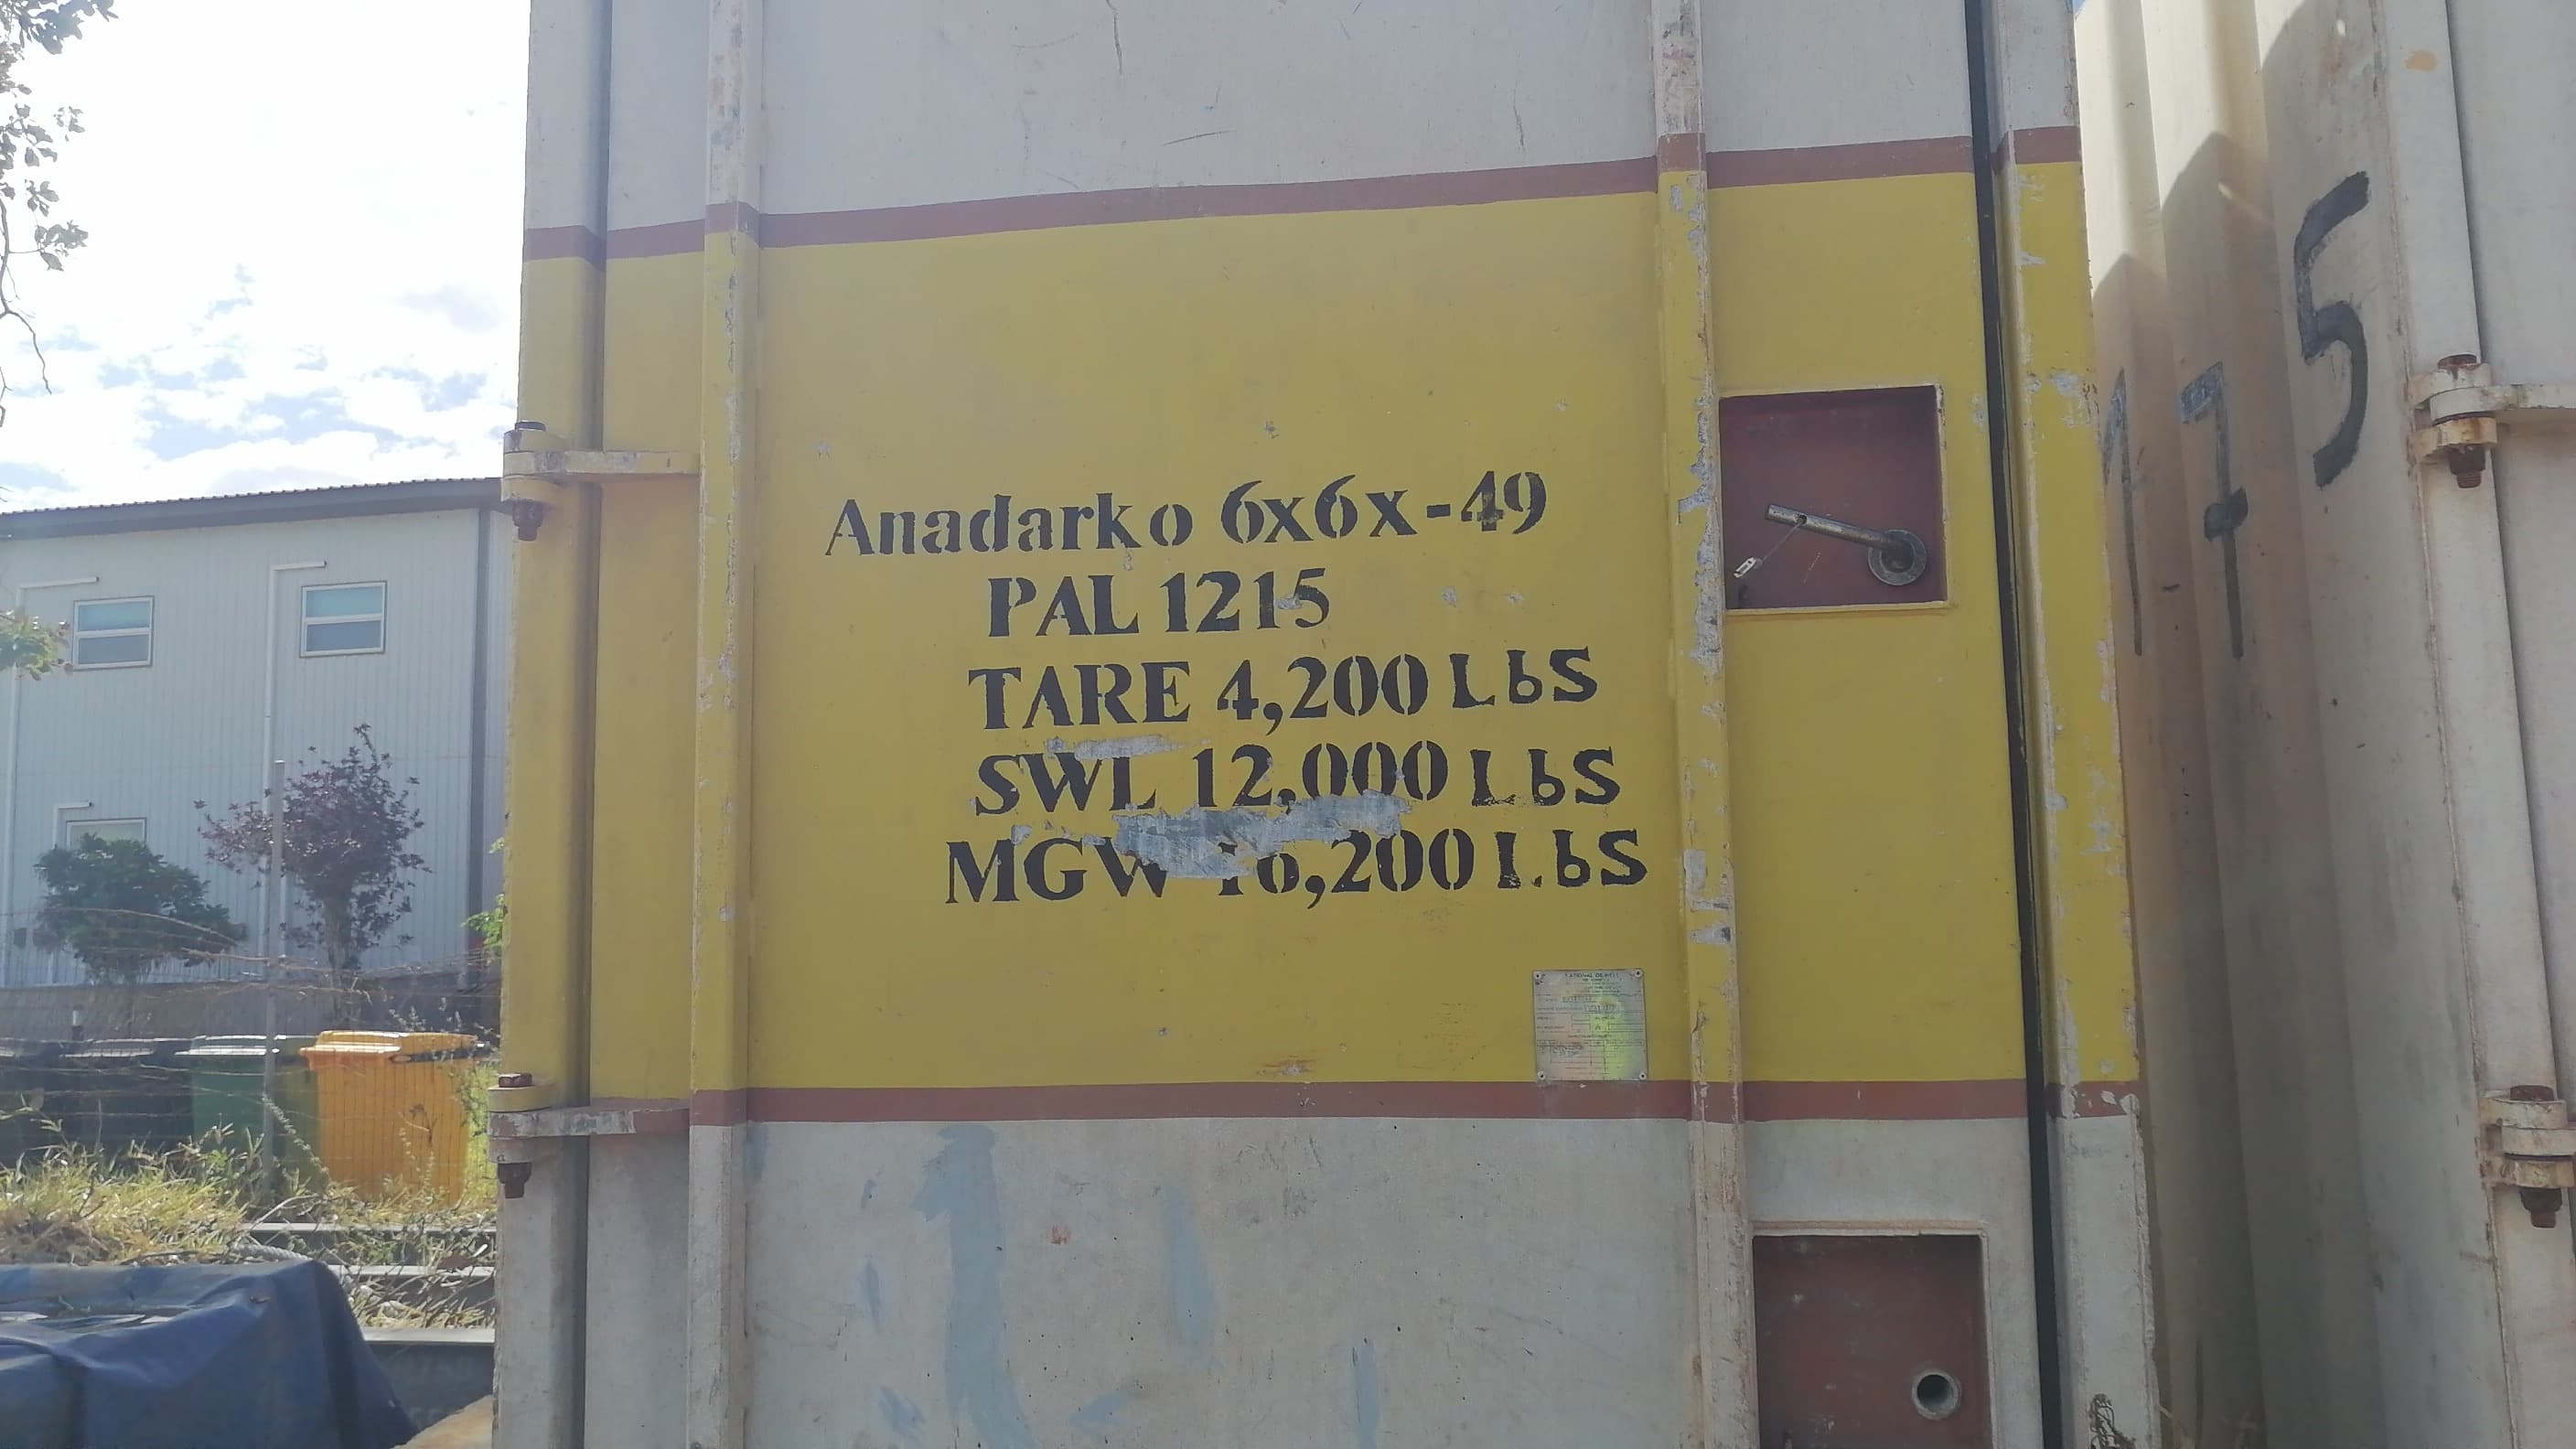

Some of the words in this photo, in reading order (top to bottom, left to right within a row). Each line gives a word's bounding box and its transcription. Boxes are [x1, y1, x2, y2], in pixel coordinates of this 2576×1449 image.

[825, 492, 1193, 555] Anadarko
[1220, 470, 1547, 543] 6x6x-49
[987, 574, 1140, 637] PAL
[1159, 567, 1330, 633] 1215
[968, 660, 1191, 730] TARE
[1217, 653, 1429, 735] 4,200
[974, 752, 1157, 816] SWL
